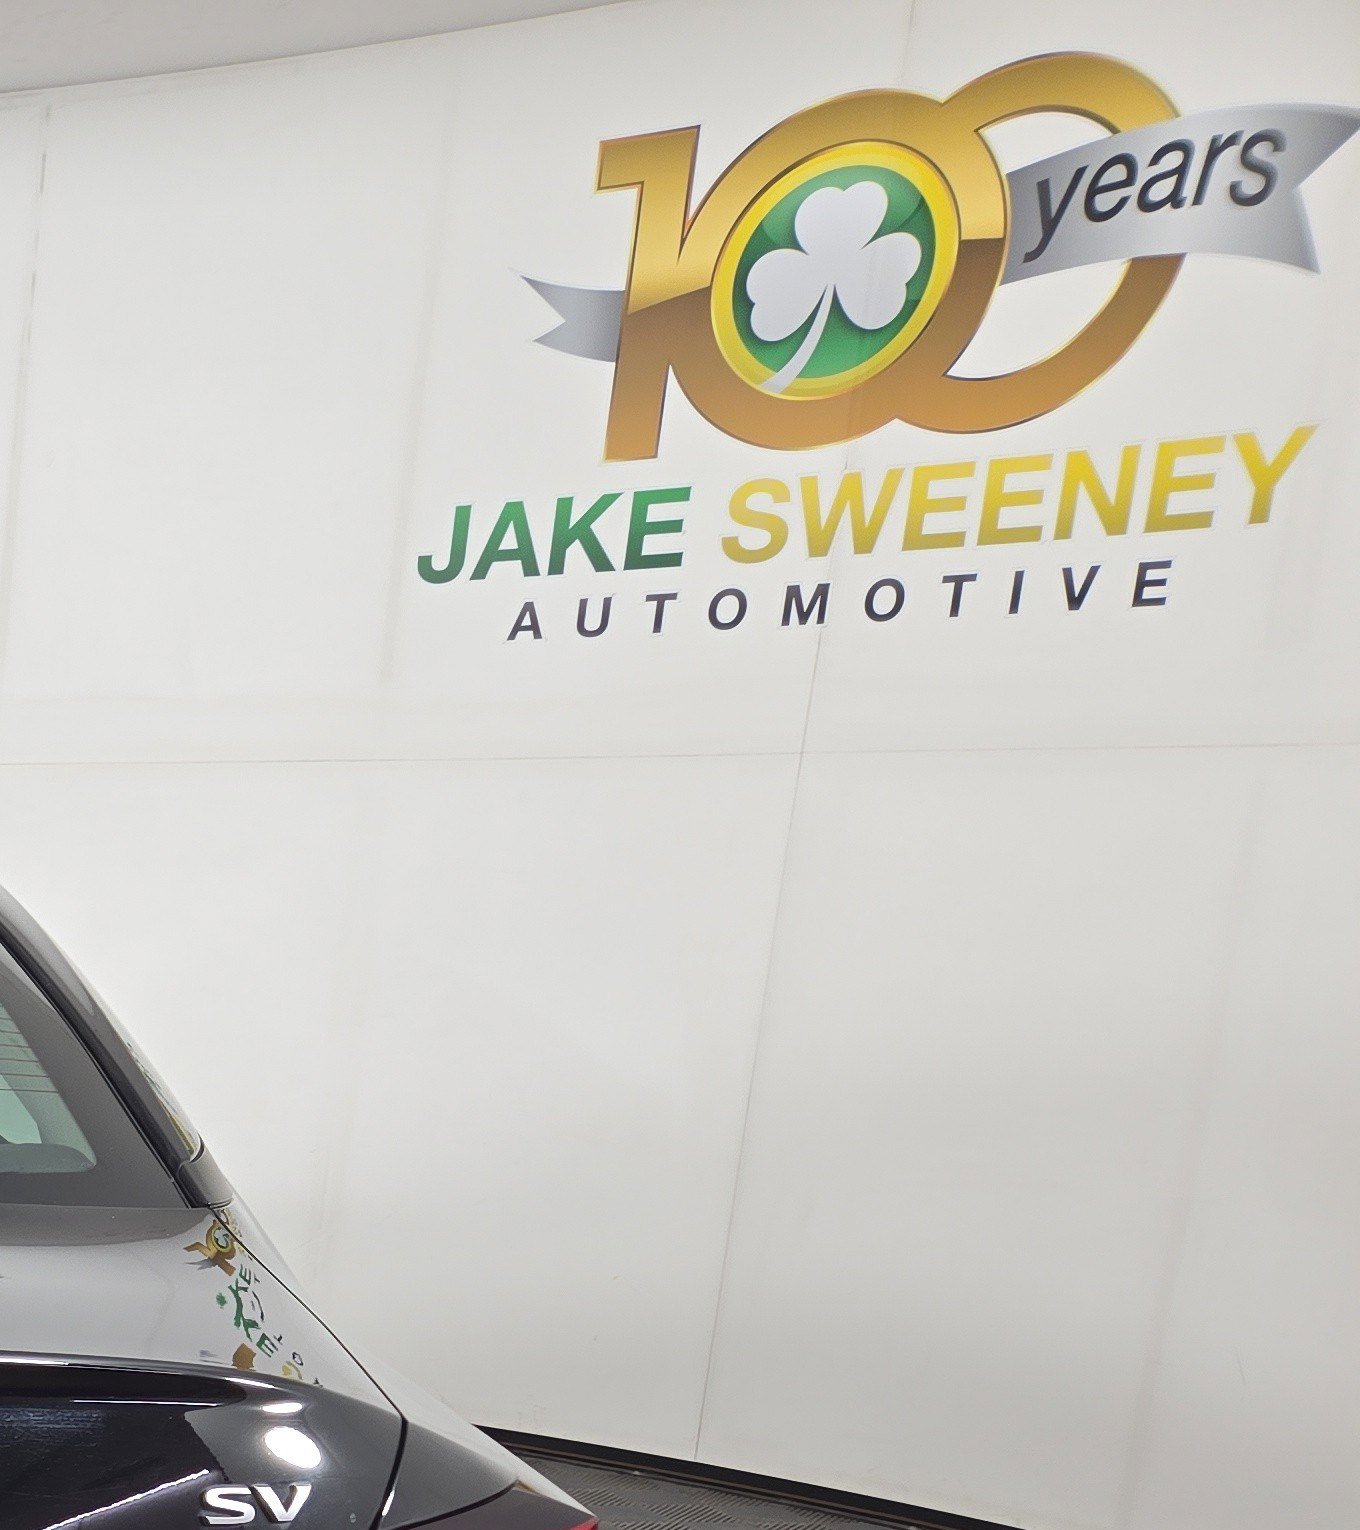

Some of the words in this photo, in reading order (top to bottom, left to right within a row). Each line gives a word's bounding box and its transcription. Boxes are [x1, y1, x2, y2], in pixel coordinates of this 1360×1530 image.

[1022, 127, 1286, 264] years
[417, 487, 692, 585] JAKE
[720, 424, 1319, 564] SWEENEY
[507, 559, 1173, 641] AUTOMOTIVE
[200, 1484, 312, 1526] SV
